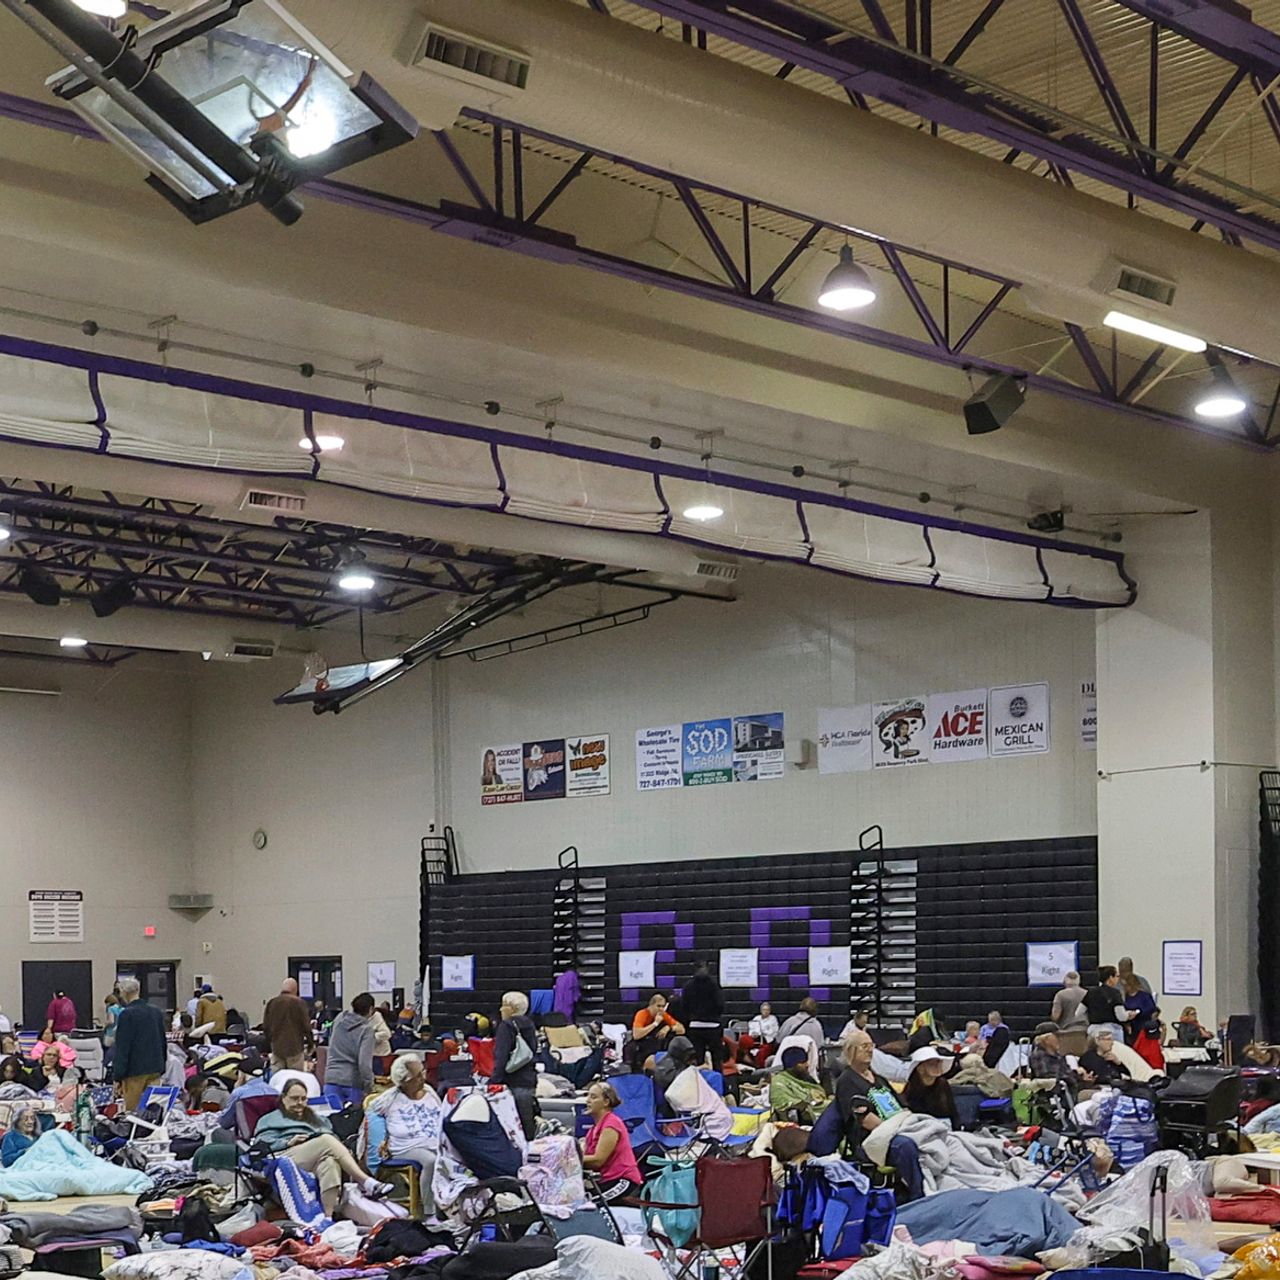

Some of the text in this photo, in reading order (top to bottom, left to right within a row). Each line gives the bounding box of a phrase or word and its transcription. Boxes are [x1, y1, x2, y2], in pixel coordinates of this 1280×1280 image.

[954, 703, 984, 713] Burkett
[933, 711, 984, 739] ACE
[995, 722, 1044, 736] MEXICAN
[686, 728, 728, 755] SOD
[933, 737, 984, 750] Hardware
[1004, 735, 1034, 747] GRILL
[692, 754, 724, 768] FARM
[1048, 952, 1054, 960] 5
[822, 968, 839, 978] Right
[1041, 966, 1060, 976] Right
